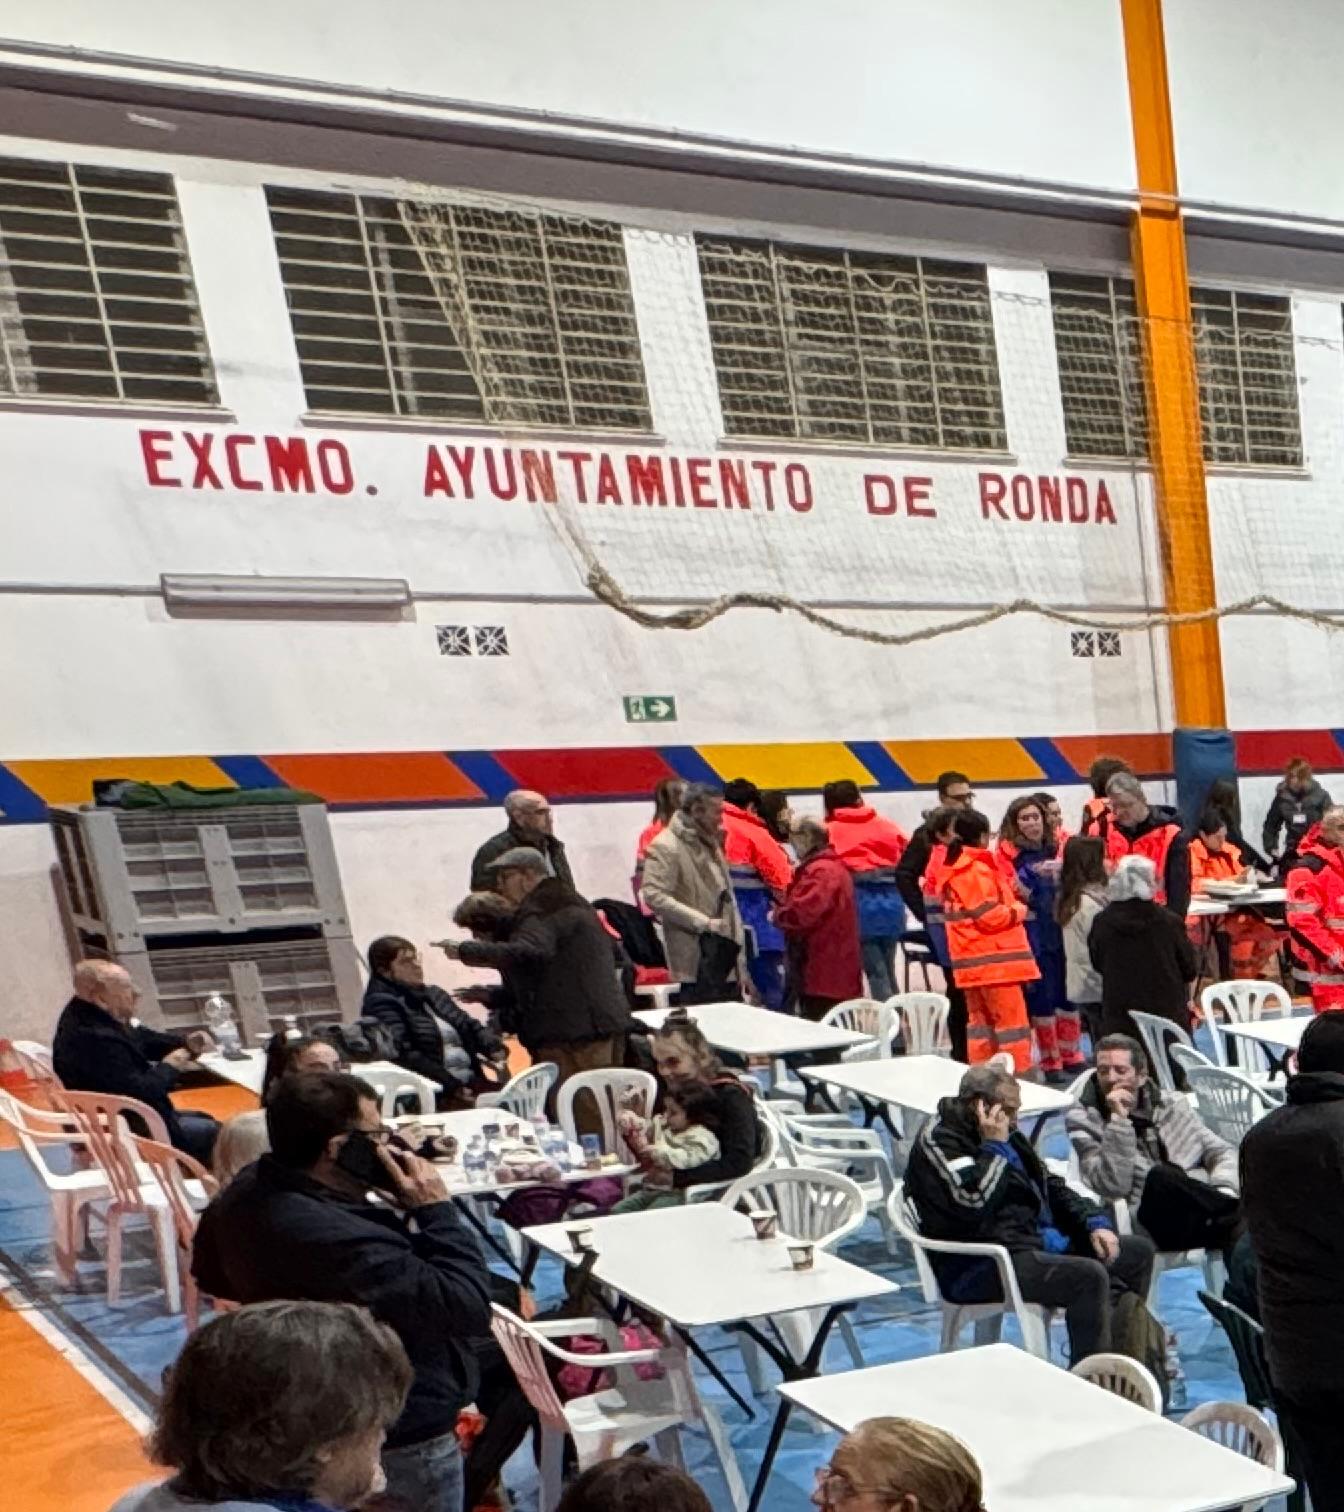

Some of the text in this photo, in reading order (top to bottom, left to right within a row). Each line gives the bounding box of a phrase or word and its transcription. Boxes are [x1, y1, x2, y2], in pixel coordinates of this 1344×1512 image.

[139, 430, 1117, 524] EXCMO. AYUNTAMIENTO DE RONDA
